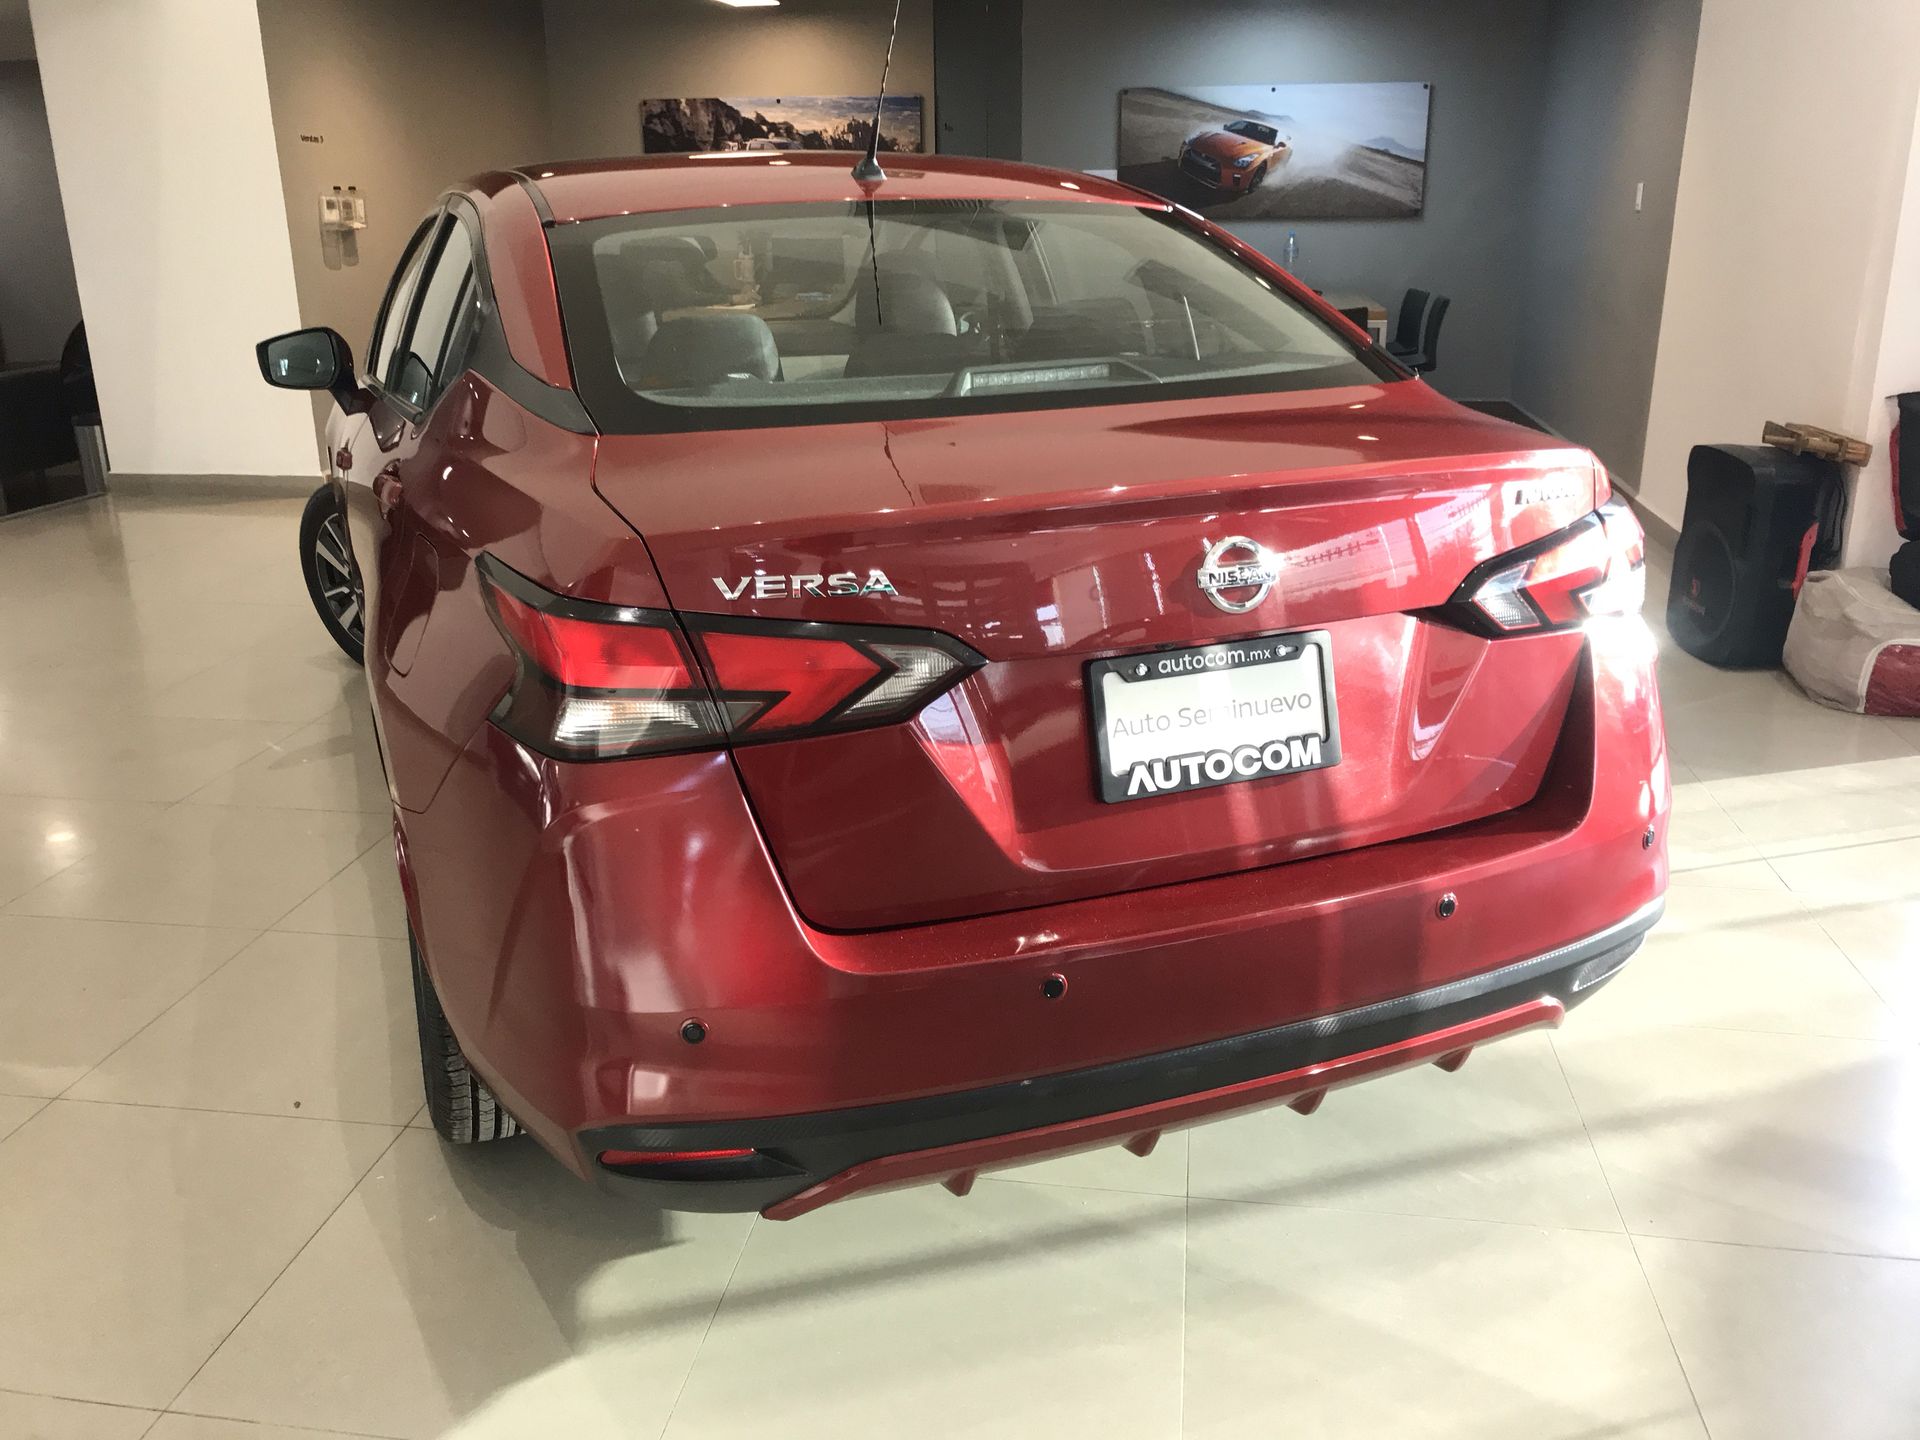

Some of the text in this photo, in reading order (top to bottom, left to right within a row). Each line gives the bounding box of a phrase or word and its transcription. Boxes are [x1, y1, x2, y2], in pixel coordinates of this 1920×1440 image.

[712, 570, 898, 601] VERSA
[1158, 648, 1272, 674] autocom.mx
[1113, 714, 1171, 738] Auto
[1127, 736, 1322, 796] AUTOCOM
